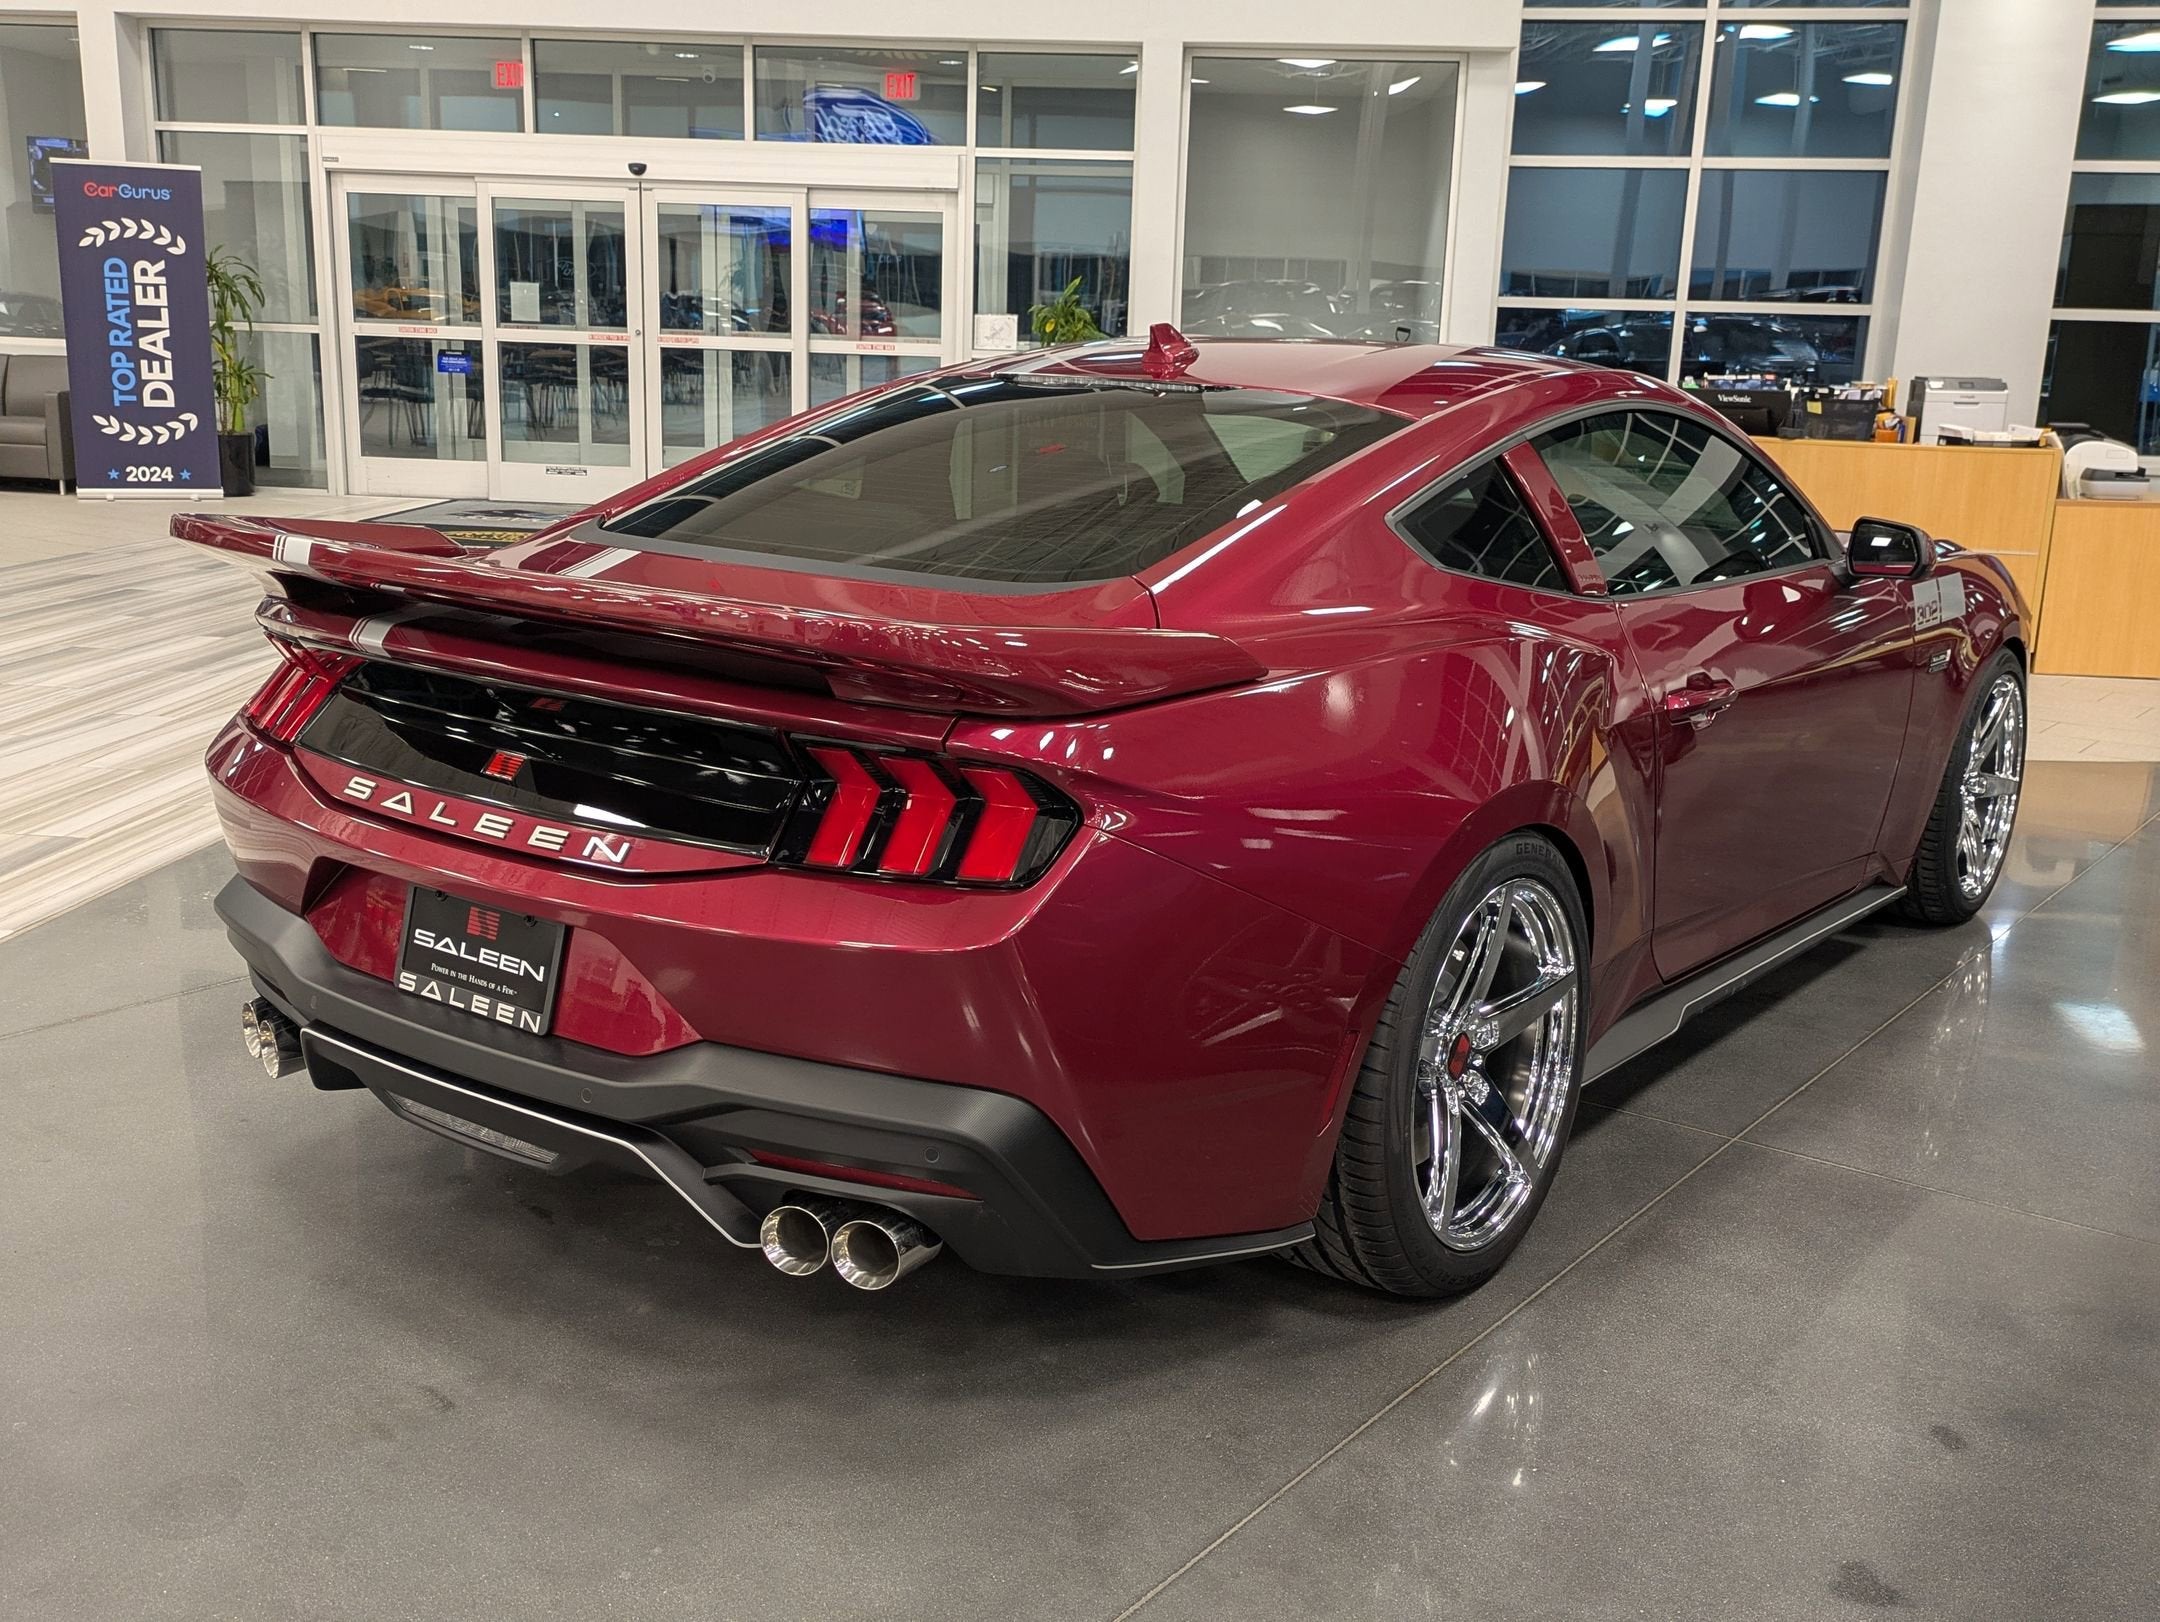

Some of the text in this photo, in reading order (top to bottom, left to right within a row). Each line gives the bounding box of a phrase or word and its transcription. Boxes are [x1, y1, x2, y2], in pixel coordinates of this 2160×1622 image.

[886, 73, 916, 98] EXIT
[84, 181, 171, 201] CarGurus
[103, 256, 137, 407] TOP RATED
[133, 258, 175, 408] DEALER
[125, 466, 174, 482] 2024
[343, 776, 631, 864] SALEEN
[414, 928, 545, 982] SALEEN
[398, 971, 541, 1034] SALEEN
